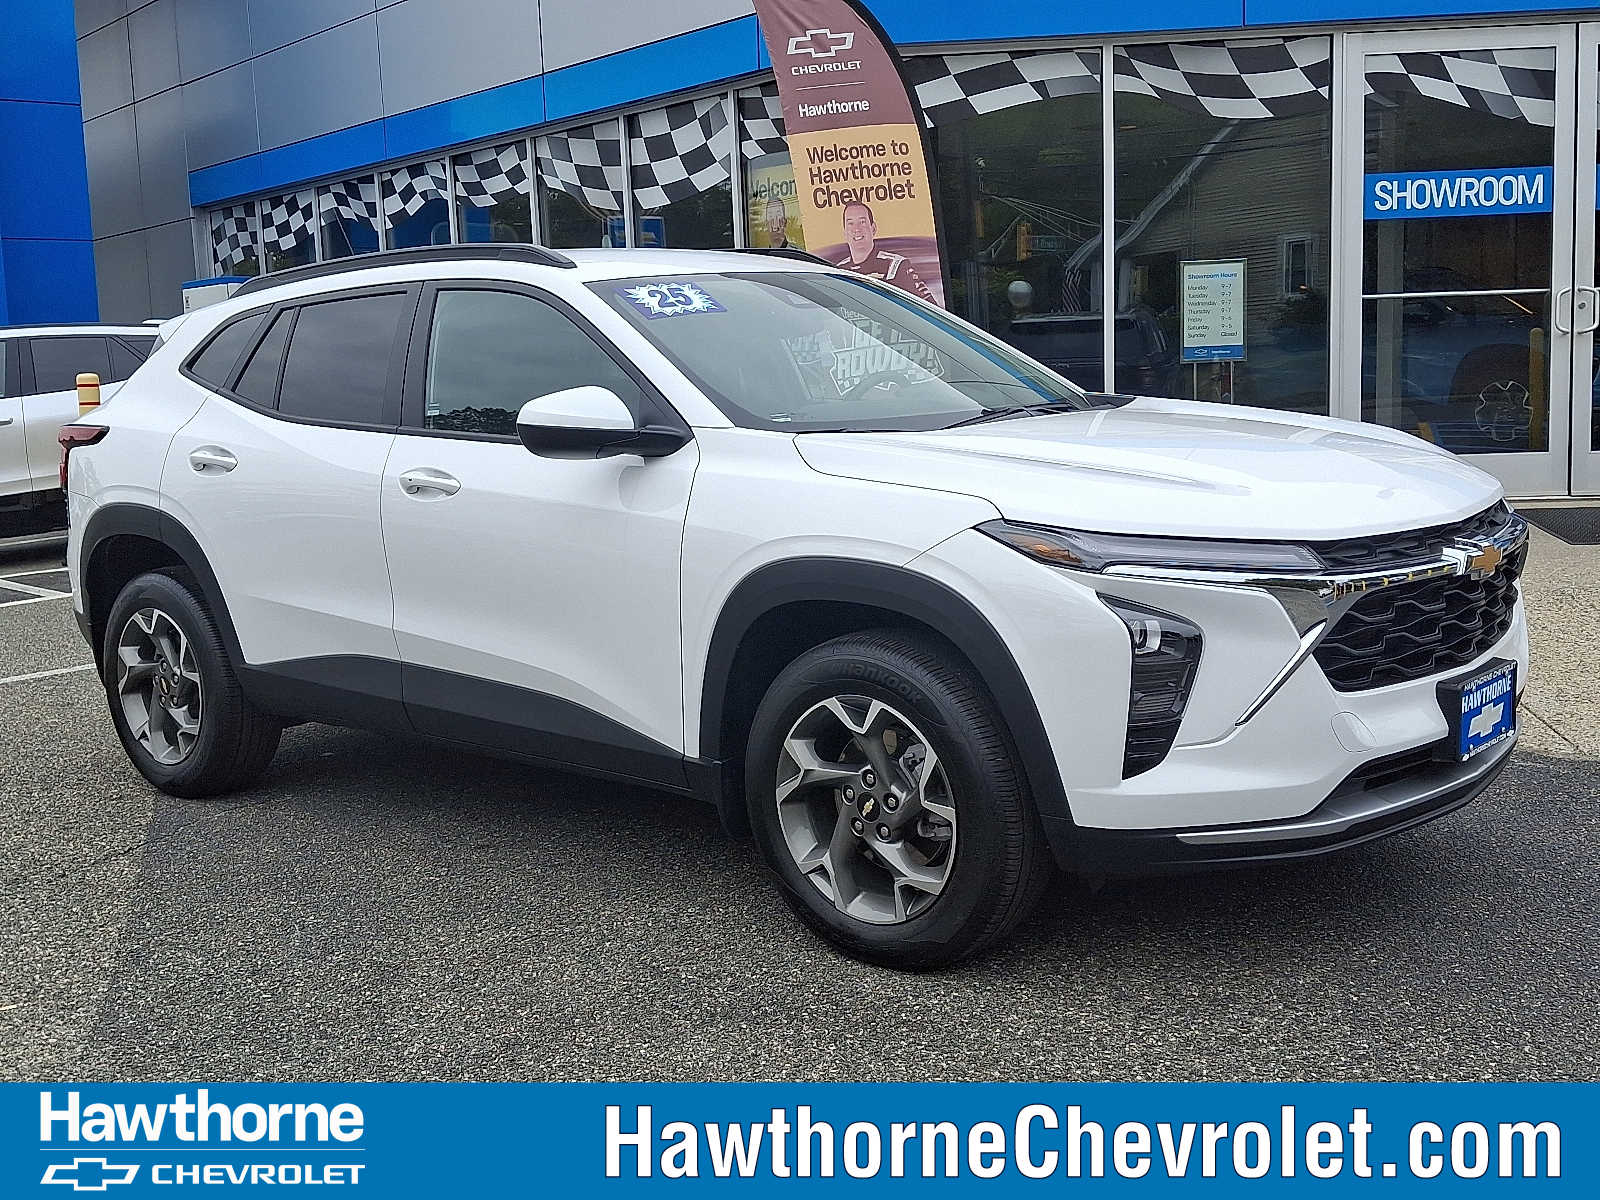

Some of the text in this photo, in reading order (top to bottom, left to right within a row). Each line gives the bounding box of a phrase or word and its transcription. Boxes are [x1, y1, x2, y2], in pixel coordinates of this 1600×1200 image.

[791, 60, 862, 76] CHEVROLET
[798, 99, 870, 118] Hawthorne
[806, 140, 909, 165] Welcome to
[808, 160, 912, 186] Hawthorne
[812, 178, 916, 209] Chevrolet
[1374, 174, 1544, 211] SHOWROOM
[647, 287, 694, 308] 25
[1461, 674, 1511, 713] HAWTHORNE
